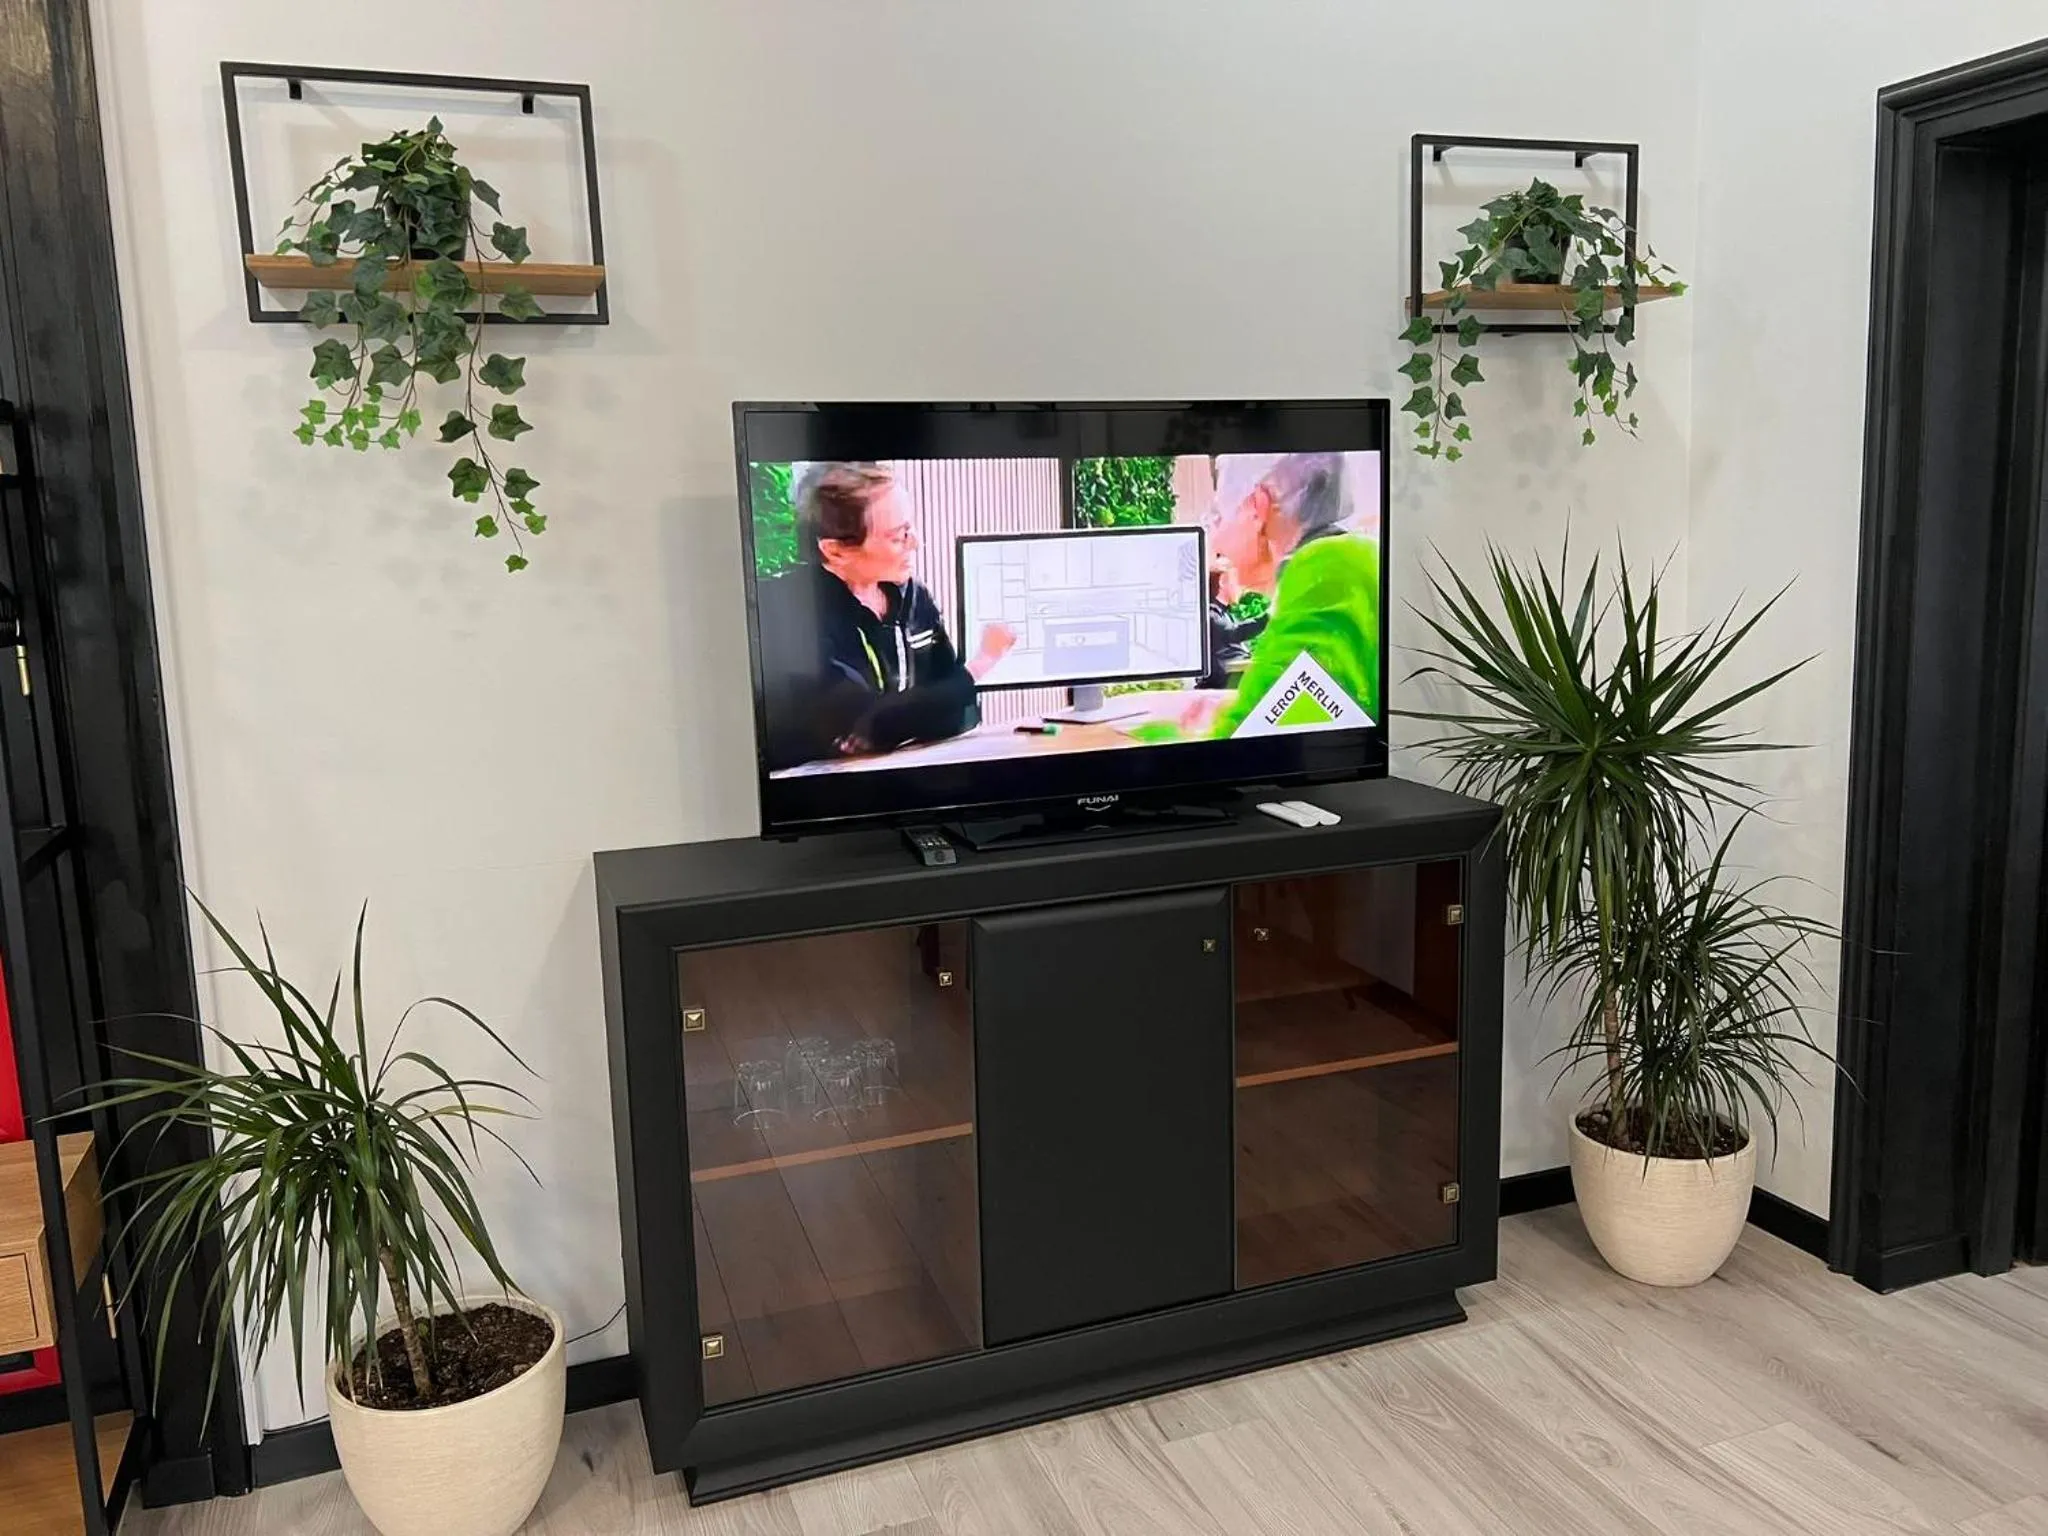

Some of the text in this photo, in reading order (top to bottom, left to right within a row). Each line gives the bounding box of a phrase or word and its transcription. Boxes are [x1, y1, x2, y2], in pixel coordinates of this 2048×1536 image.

[1264, 671, 1344, 725] LEROY MERLIN
[1077, 794, 1119, 806] FUNAI
